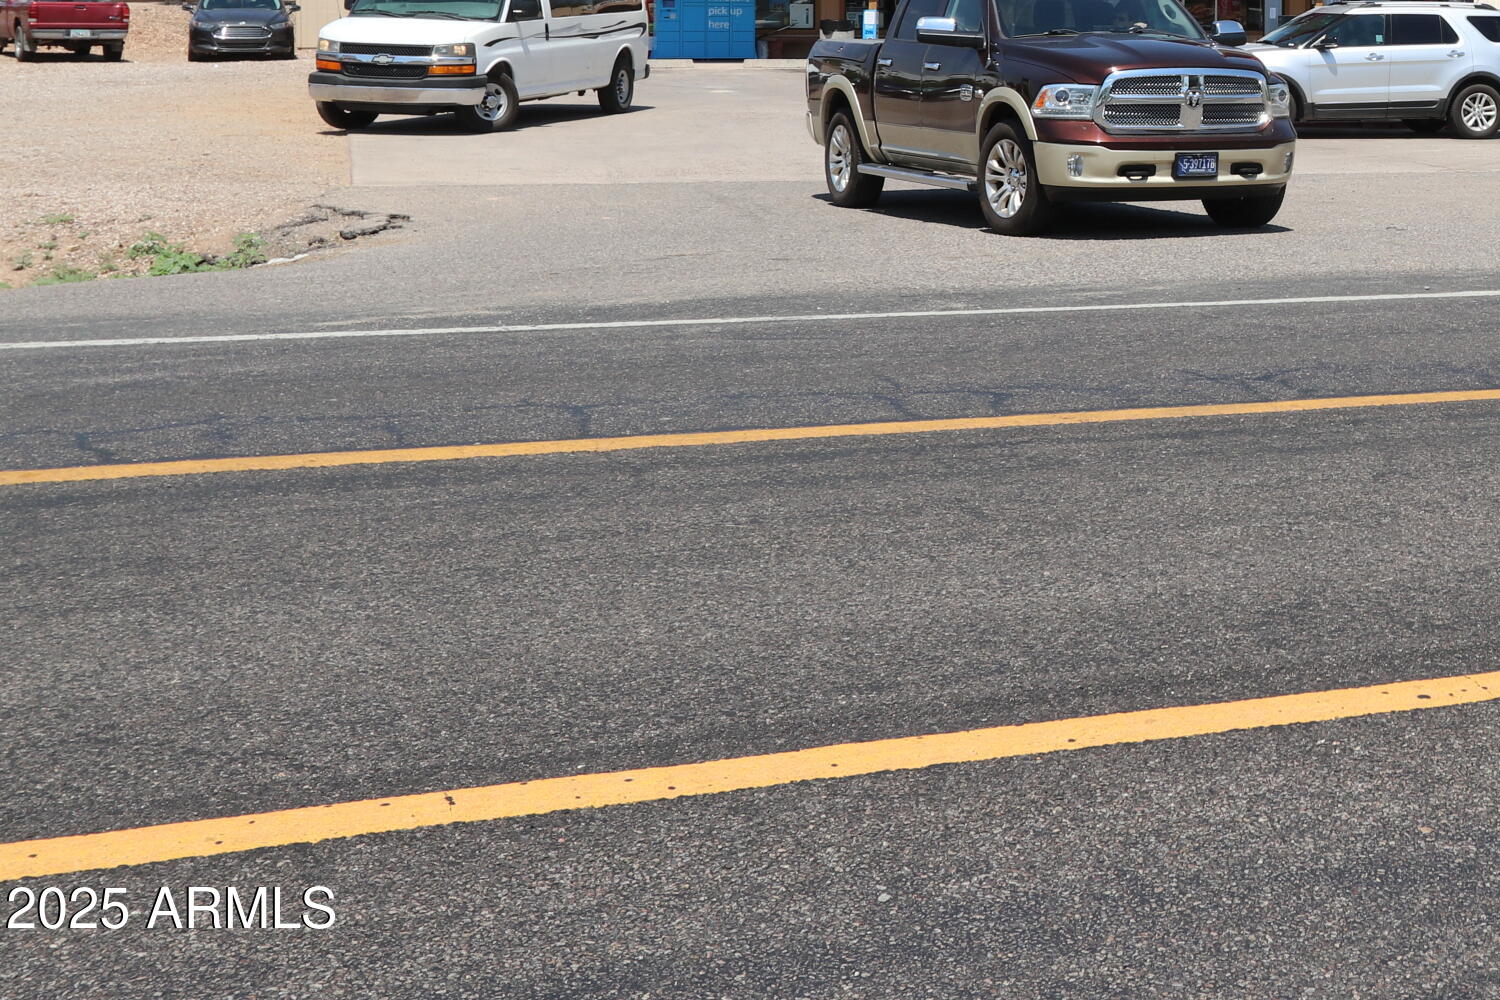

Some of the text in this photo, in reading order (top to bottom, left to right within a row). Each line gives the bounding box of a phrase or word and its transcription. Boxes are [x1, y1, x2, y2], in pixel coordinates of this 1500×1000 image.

[708, 6, 743, 17] pick up
[708, 20, 730, 29] here
